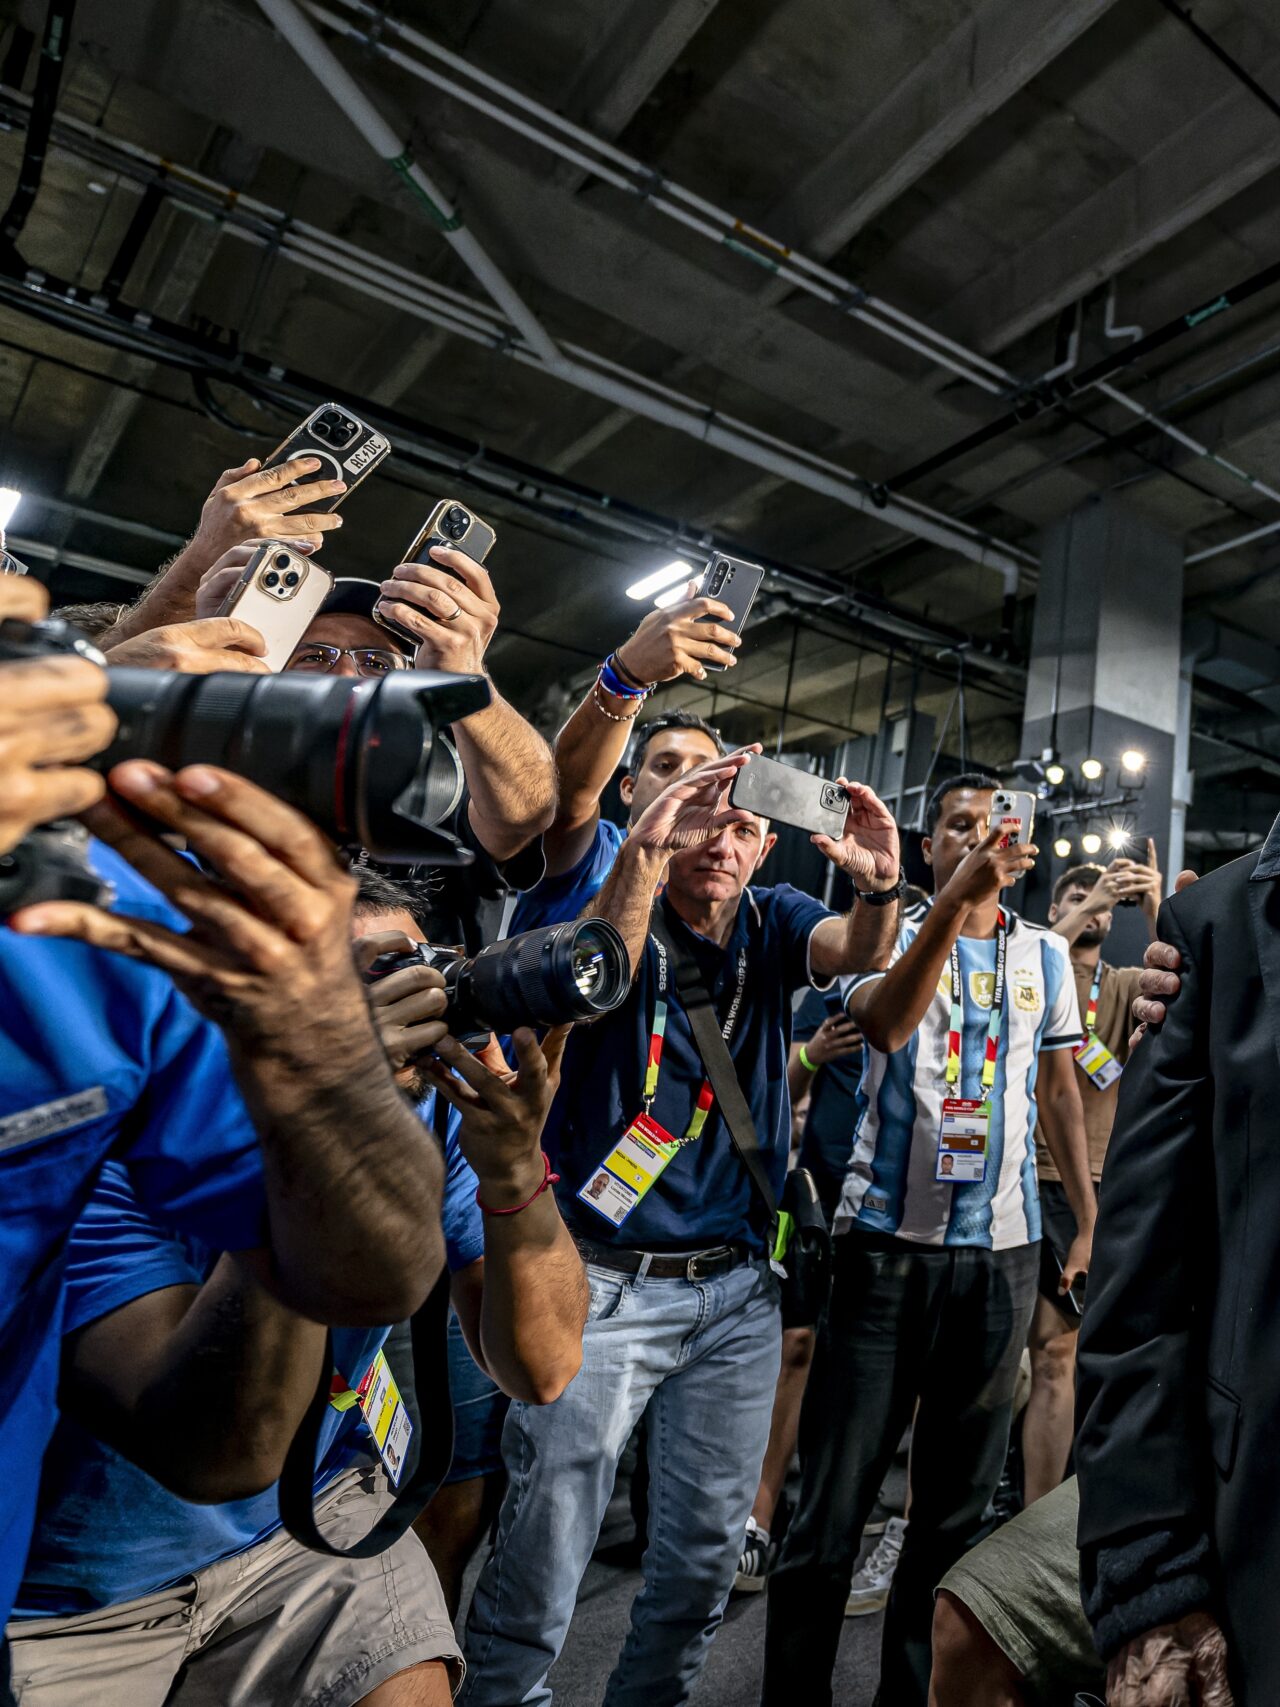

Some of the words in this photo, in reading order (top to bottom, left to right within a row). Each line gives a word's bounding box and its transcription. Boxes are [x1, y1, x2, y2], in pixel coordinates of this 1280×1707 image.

[658, 957, 667, 992] 2026
[722, 1018, 734, 1040] FIFA
[728, 987, 743, 1019] WORLD
